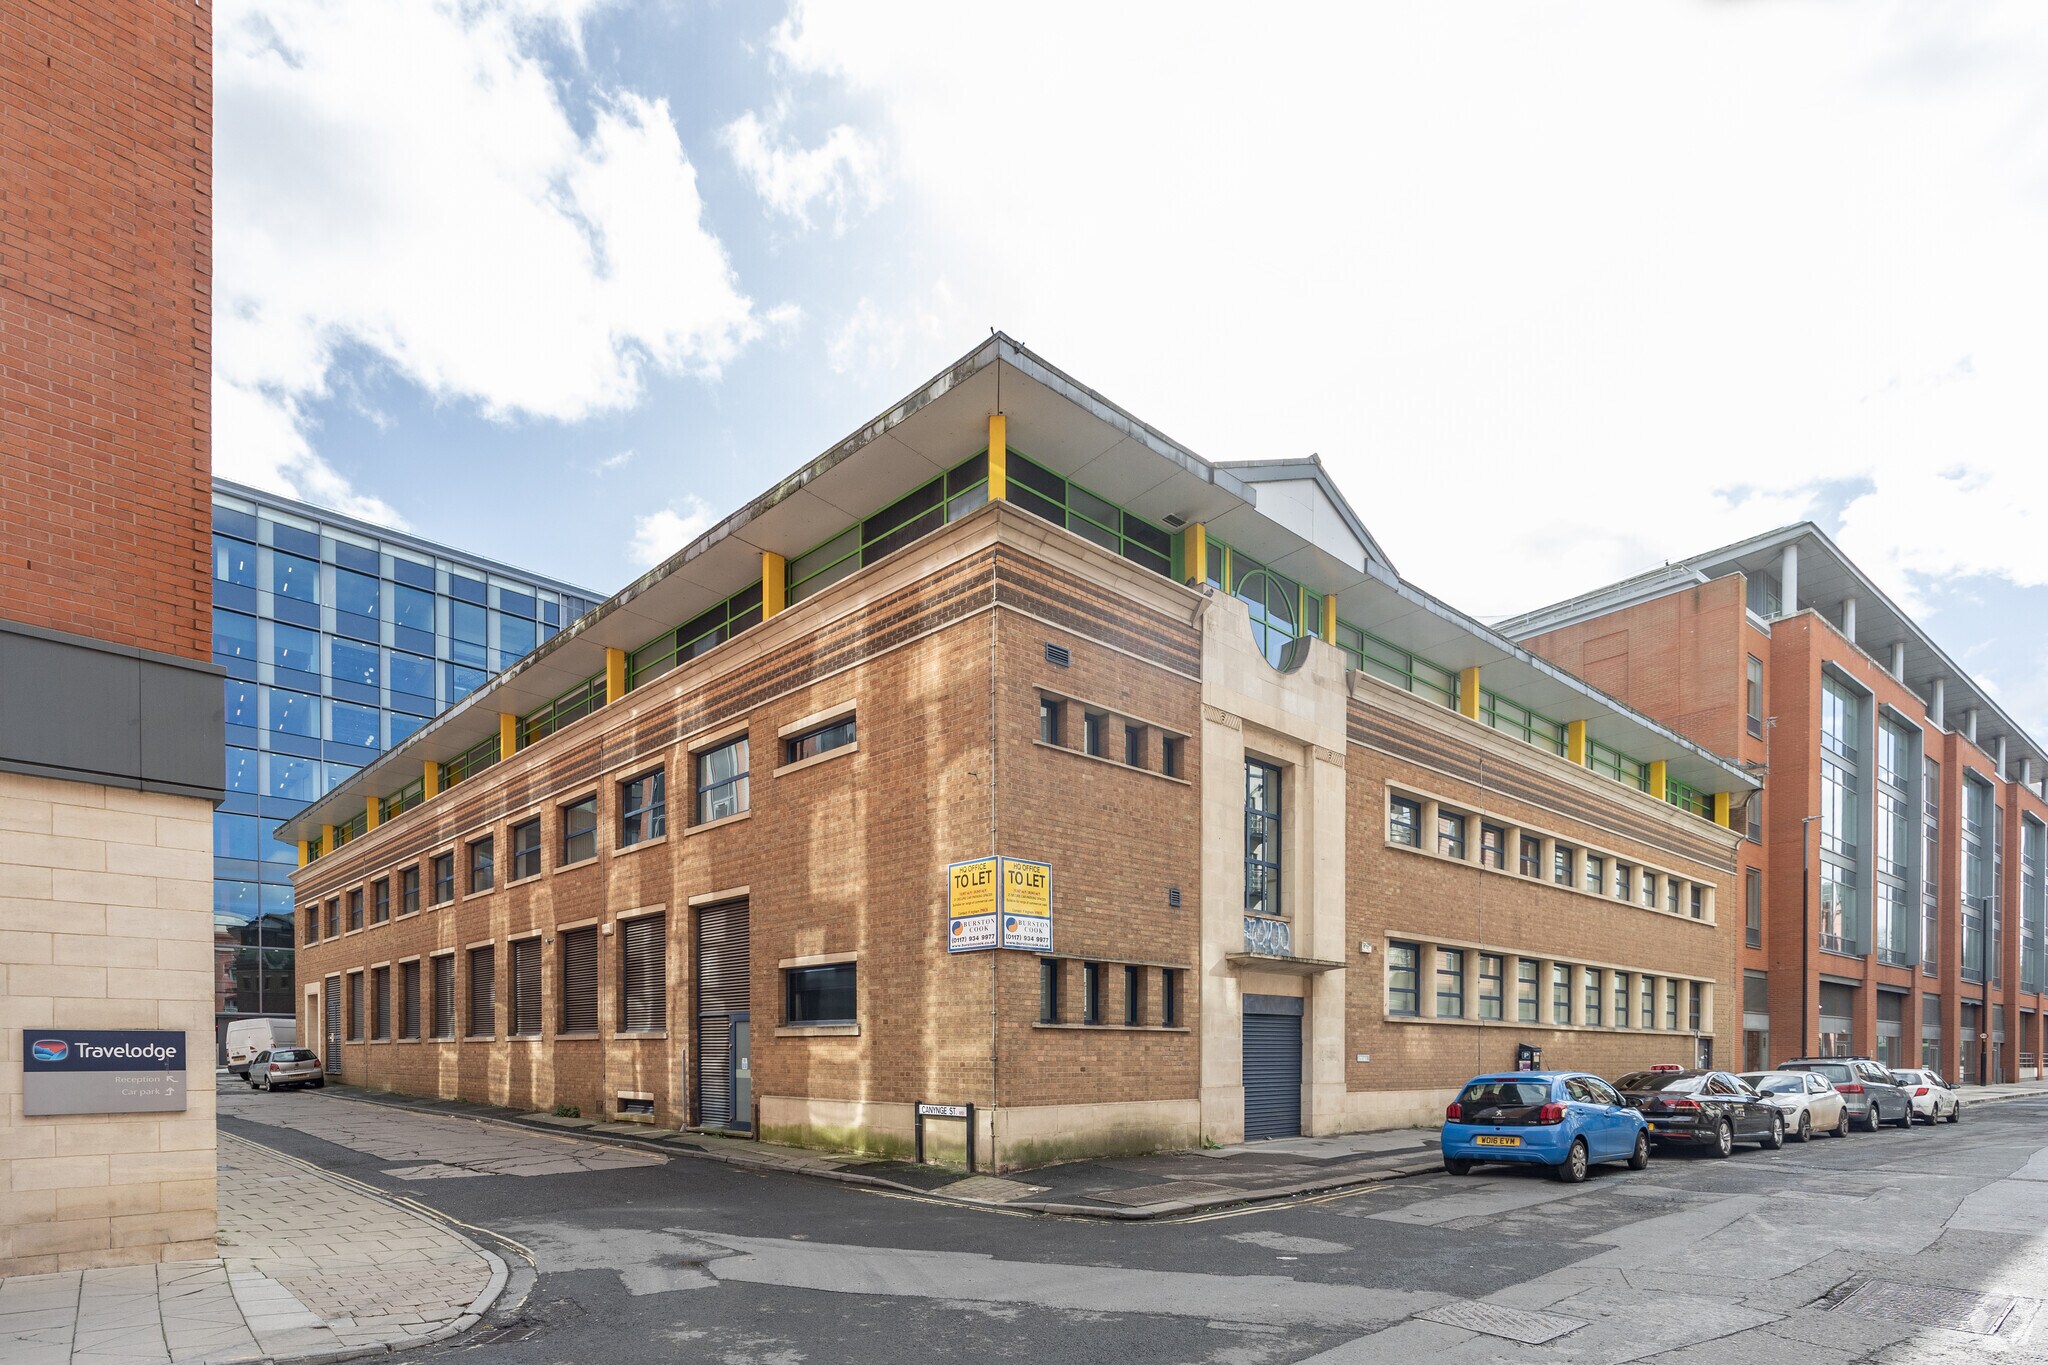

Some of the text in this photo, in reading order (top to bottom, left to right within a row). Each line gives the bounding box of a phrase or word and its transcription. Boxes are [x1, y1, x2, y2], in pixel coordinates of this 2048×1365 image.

[968, 863, 986, 872] OFFICE
[1022, 864, 1040, 873] OFFICE
[954, 869, 992, 889] TO LET
[1008, 870, 1046, 888] TO LET
[964, 918, 995, 927] BURSTON
[1018, 920, 1049, 928] BURSTON
[74, 1042, 177, 1061] Travelodge
[115, 1076, 160, 1084] Reception
[140, 1088, 160, 1097] park
[922, 1106, 947, 1114] CANYNGE
